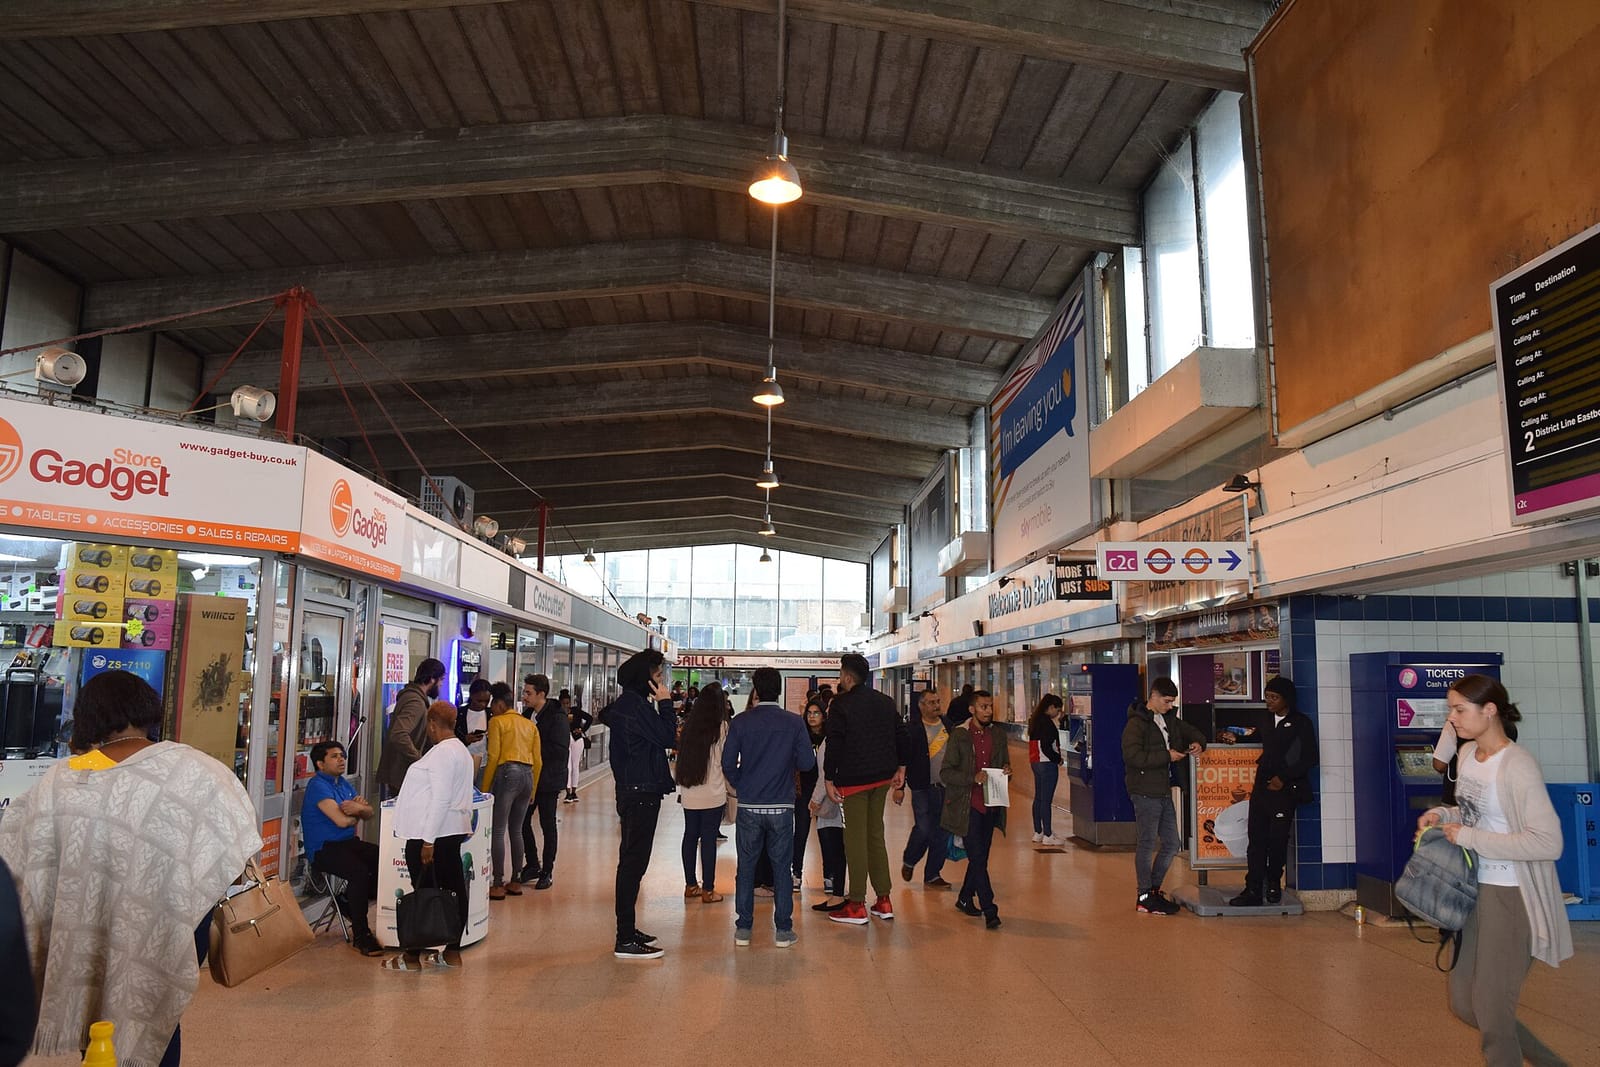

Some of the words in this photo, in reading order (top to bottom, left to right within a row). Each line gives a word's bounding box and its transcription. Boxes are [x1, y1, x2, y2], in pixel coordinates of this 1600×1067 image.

[1509, 290, 1526, 305] Time
[1535, 264, 1577, 291] Destination
[1511, 311, 1530, 327] Calling
[1530, 307, 1539, 318] At:
[1513, 331, 1532, 347] Calling
[1532, 328, 1541, 339] At:
[1515, 352, 1534, 368] Calling
[1534, 349, 1543, 360] At:
[1517, 373, 1536, 388] Calling
[1536, 370, 1545, 381] At:
[1519, 394, 1538, 408] Calling
[1538, 391, 1547, 402] At:
[1013, 399, 1042, 447] leaving
[1043, 378, 1062, 425] you
[1521, 414, 1540, 429] Calling
[1540, 411, 1549, 423] At:
[1535, 422, 1560, 438] District
[1560, 418, 1576, 430] Line
[1524, 431, 1535, 453] 2
[113, 448, 161, 468] Store
[179, 441, 298, 466] www.gadget-buy.co.uk
[29, 448, 171, 501] Gadget
[1517, 500, 1528, 511] c2c
[26, 508, 81, 524] TABLETS
[103, 517, 183, 535] ACCESSORIES
[198, 527, 234, 540] SALES
[235, 531, 242, 540] &
[244, 531, 288, 546] REPAIRS
[352, 508, 387, 548] Gadget
[1056, 565, 1082, 579] MORE
[1085, 564, 1097, 577] TH
[1108, 554, 1136, 570] c2c
[988, 588, 1021, 619] Welcome
[1023, 580, 1032, 608] to
[1034, 570, 1056, 607] Bark
[1060, 580, 1082, 595] JUST
[1085, 579, 1110, 592] SUBS
[534, 585, 563, 616] Costcutter
[1198, 612, 1229, 628] COOKIES
[108, 660, 151, 670] ZS-7110
[386, 653, 404, 670] FREE
[673, 655, 725, 667] GRILLER
[1425, 669, 1465, 678] TICKETS
[1228, 757, 1256, 767] Espress
